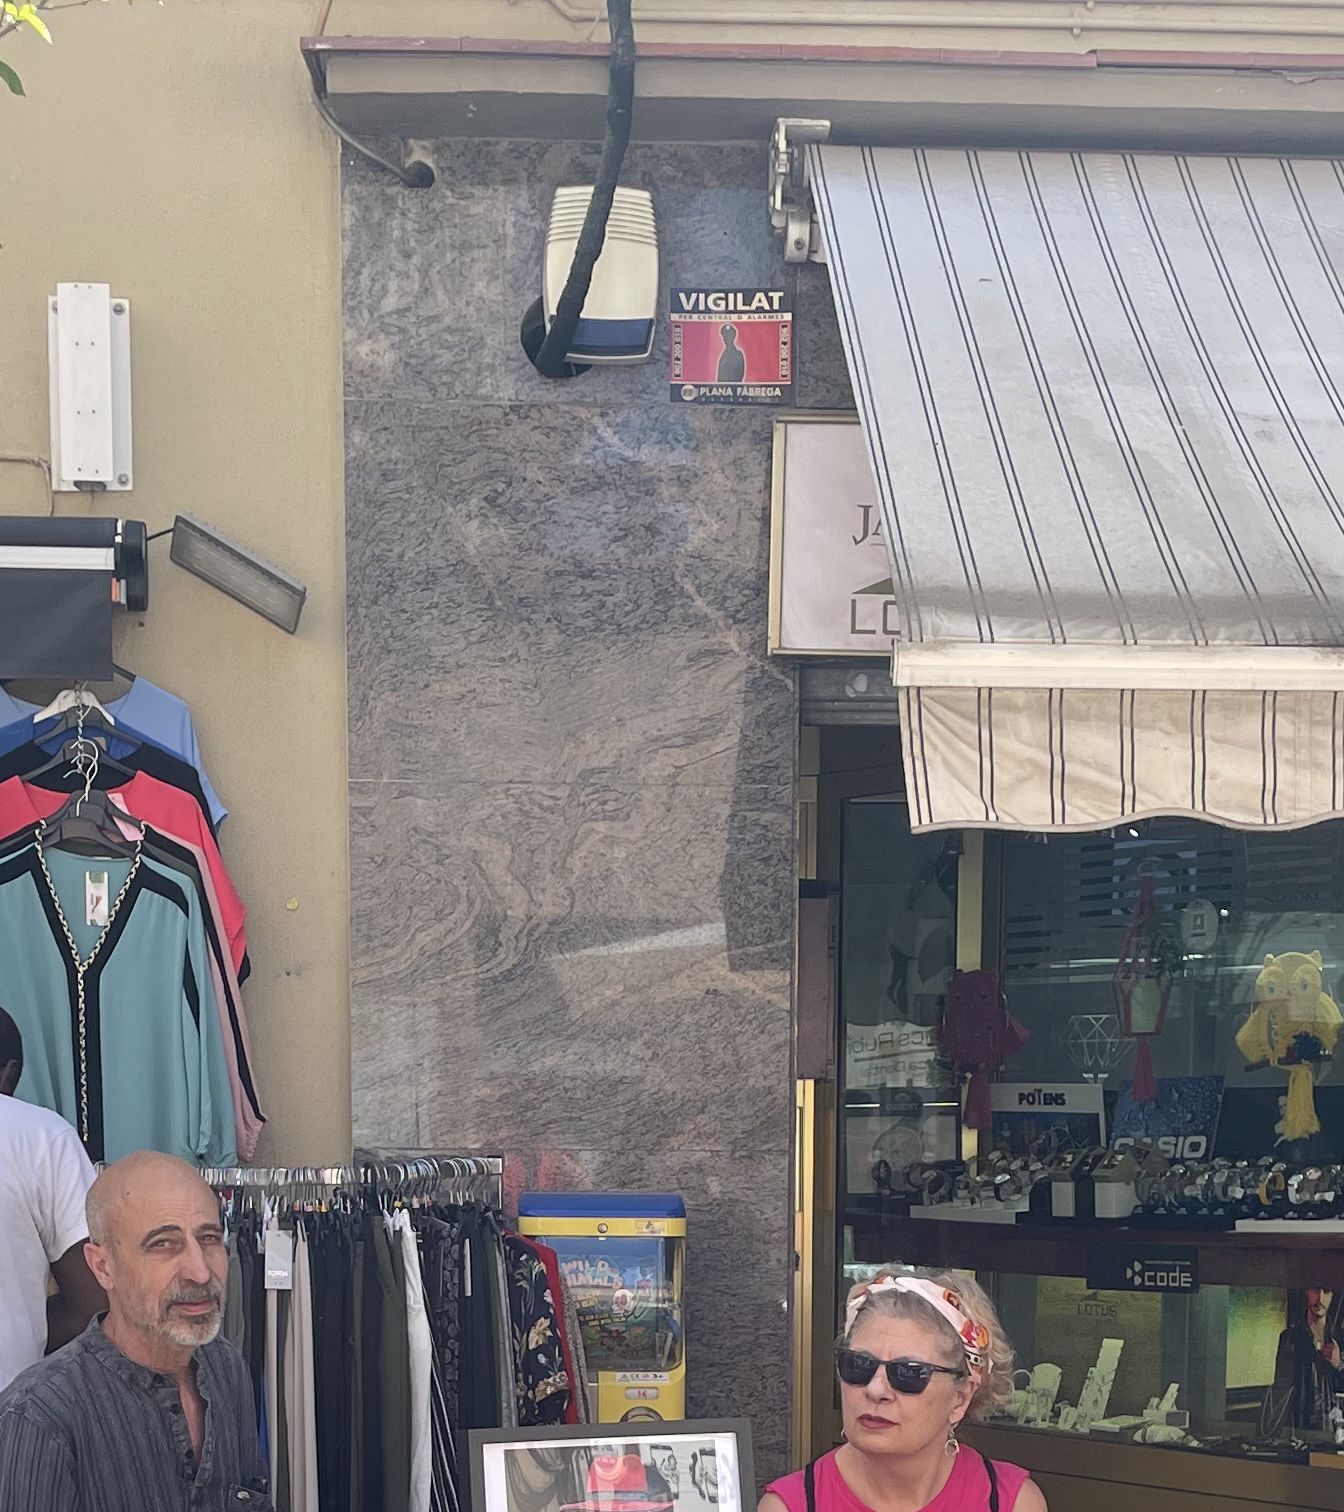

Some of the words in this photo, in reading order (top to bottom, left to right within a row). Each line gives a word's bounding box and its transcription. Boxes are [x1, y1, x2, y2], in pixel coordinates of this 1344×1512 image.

[678, 291, 784, 311] VIGILAT
[699, 387, 734, 397] PLANA
[1077, 1302, 1117, 1317] LOTUS
